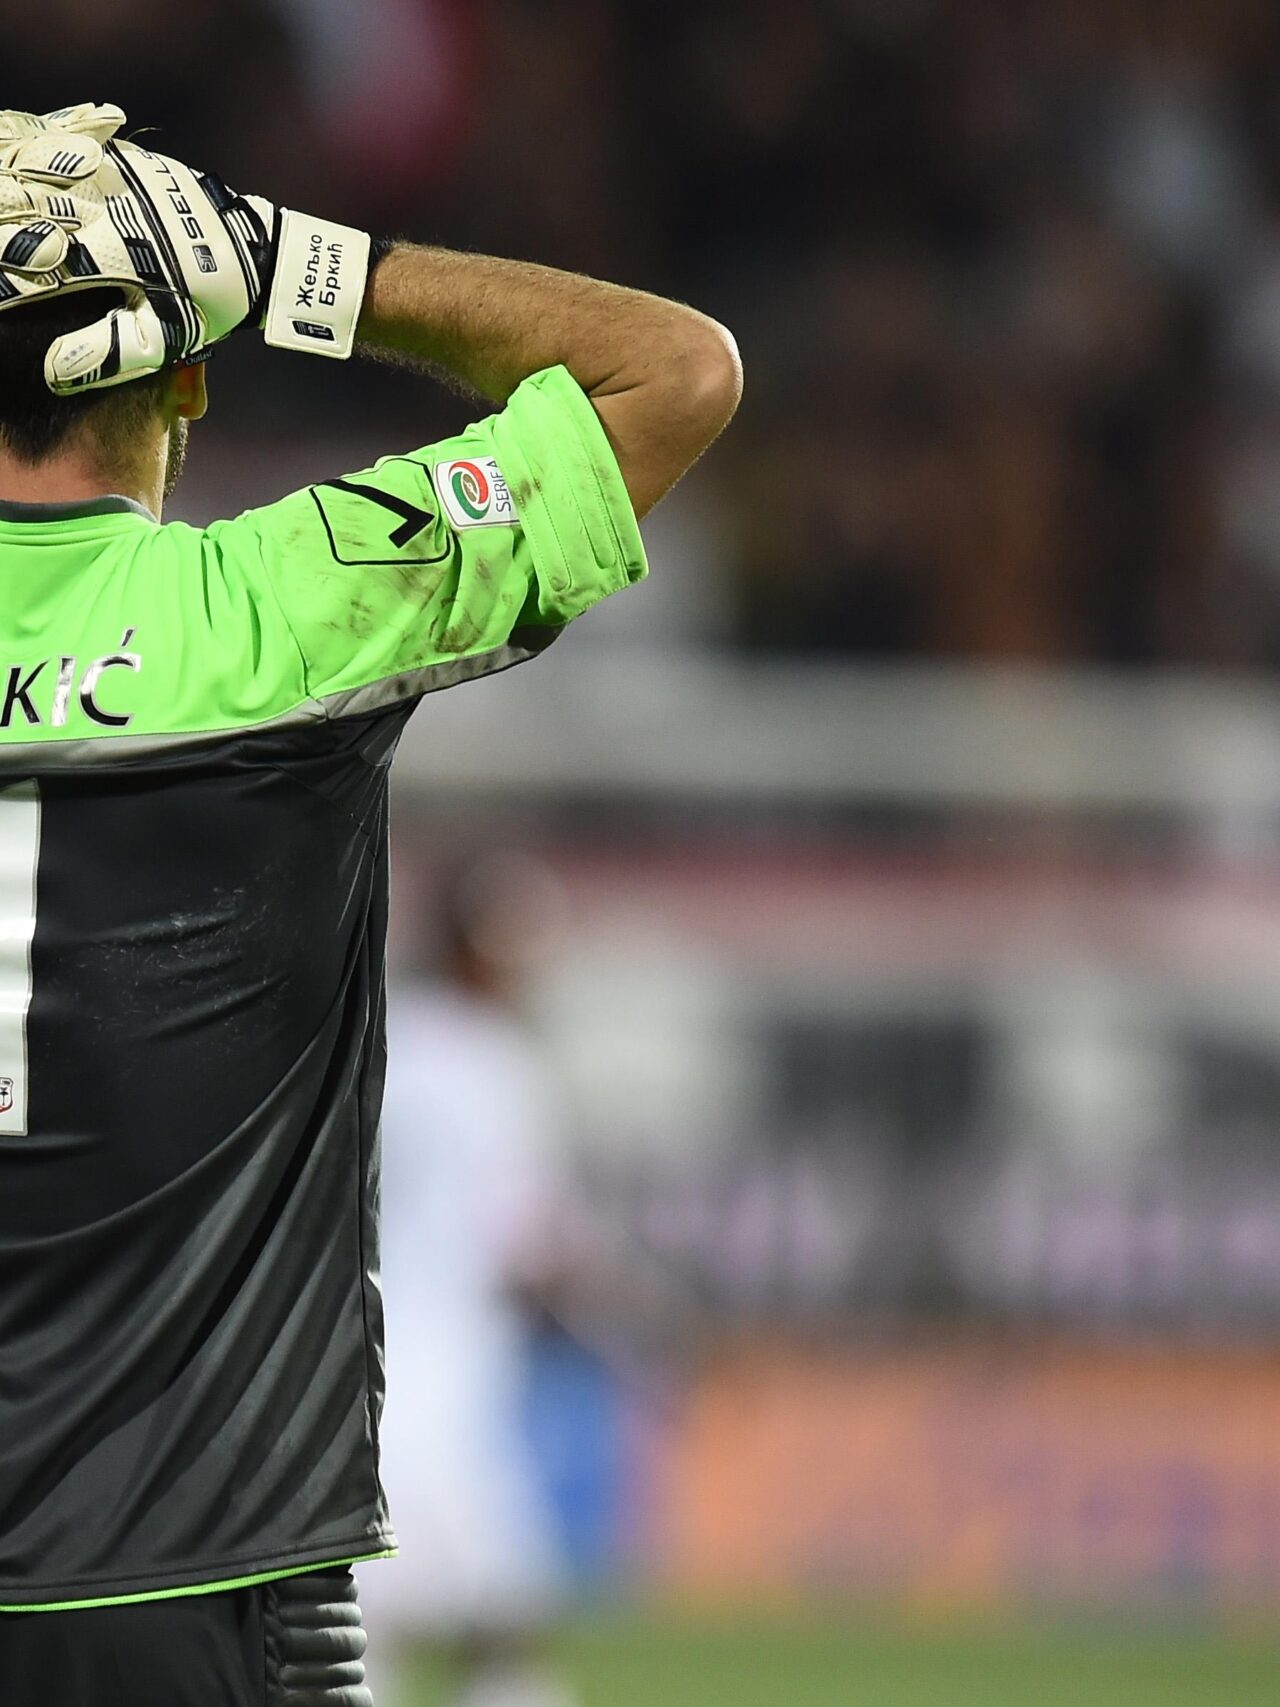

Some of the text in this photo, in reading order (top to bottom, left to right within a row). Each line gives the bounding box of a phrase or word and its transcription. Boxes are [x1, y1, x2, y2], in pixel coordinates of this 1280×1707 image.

[138, 149, 205, 240] SELLS
[295, 233, 323, 308] Жељко
[318, 242, 344, 307] Бркић
